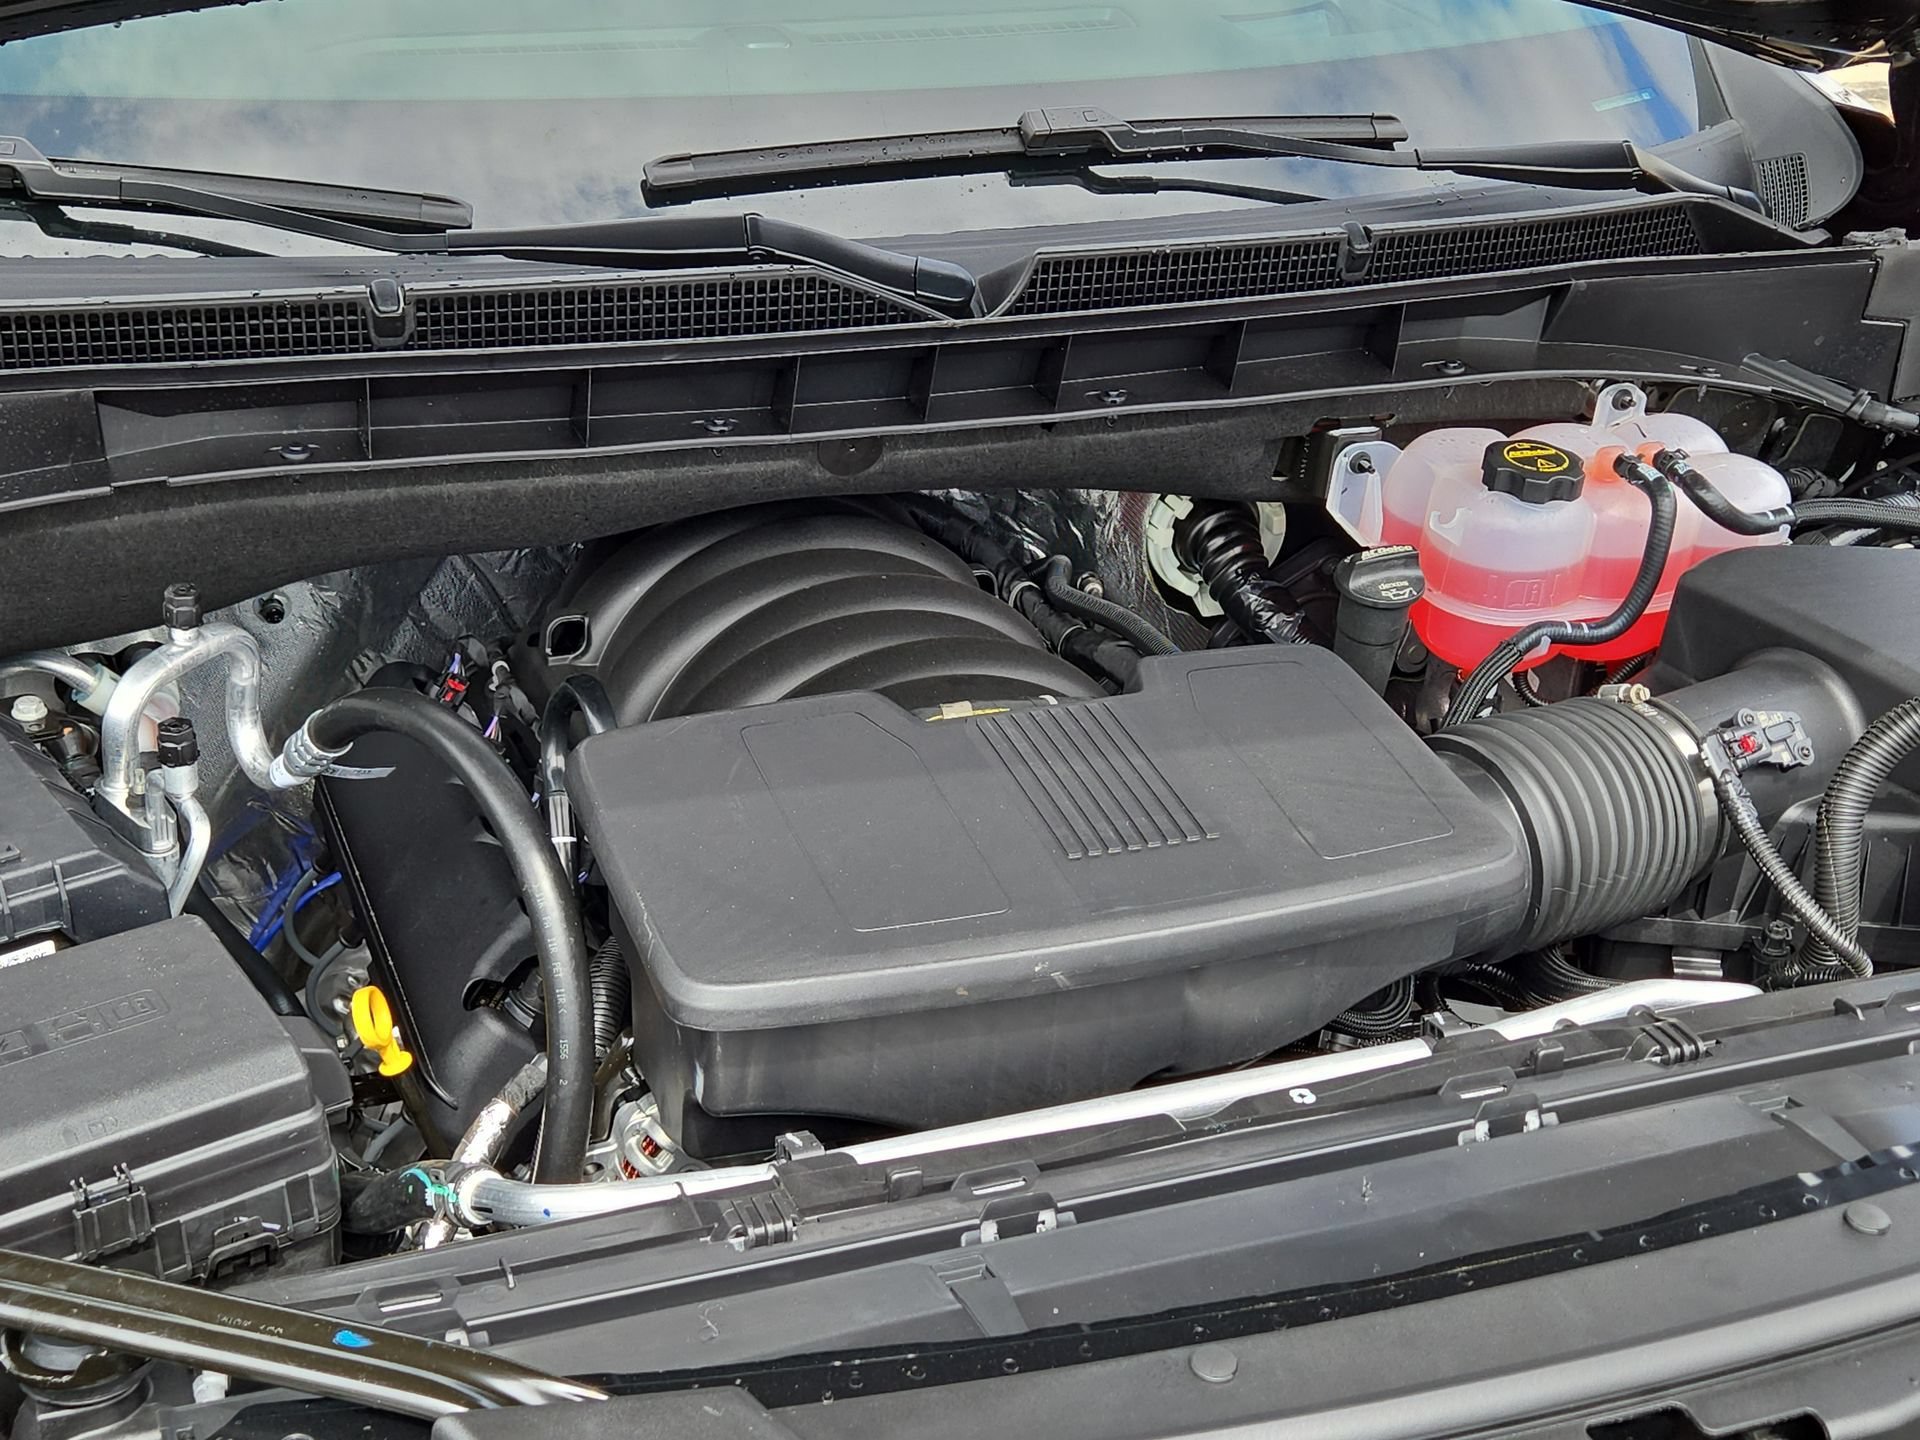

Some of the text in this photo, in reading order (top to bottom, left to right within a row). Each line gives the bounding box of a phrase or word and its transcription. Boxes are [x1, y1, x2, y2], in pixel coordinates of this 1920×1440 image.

[1361, 545, 1413, 561] ACDelco
[559, 1039, 569, 1060] 1556
[559, 1078, 568, 1086] 2
